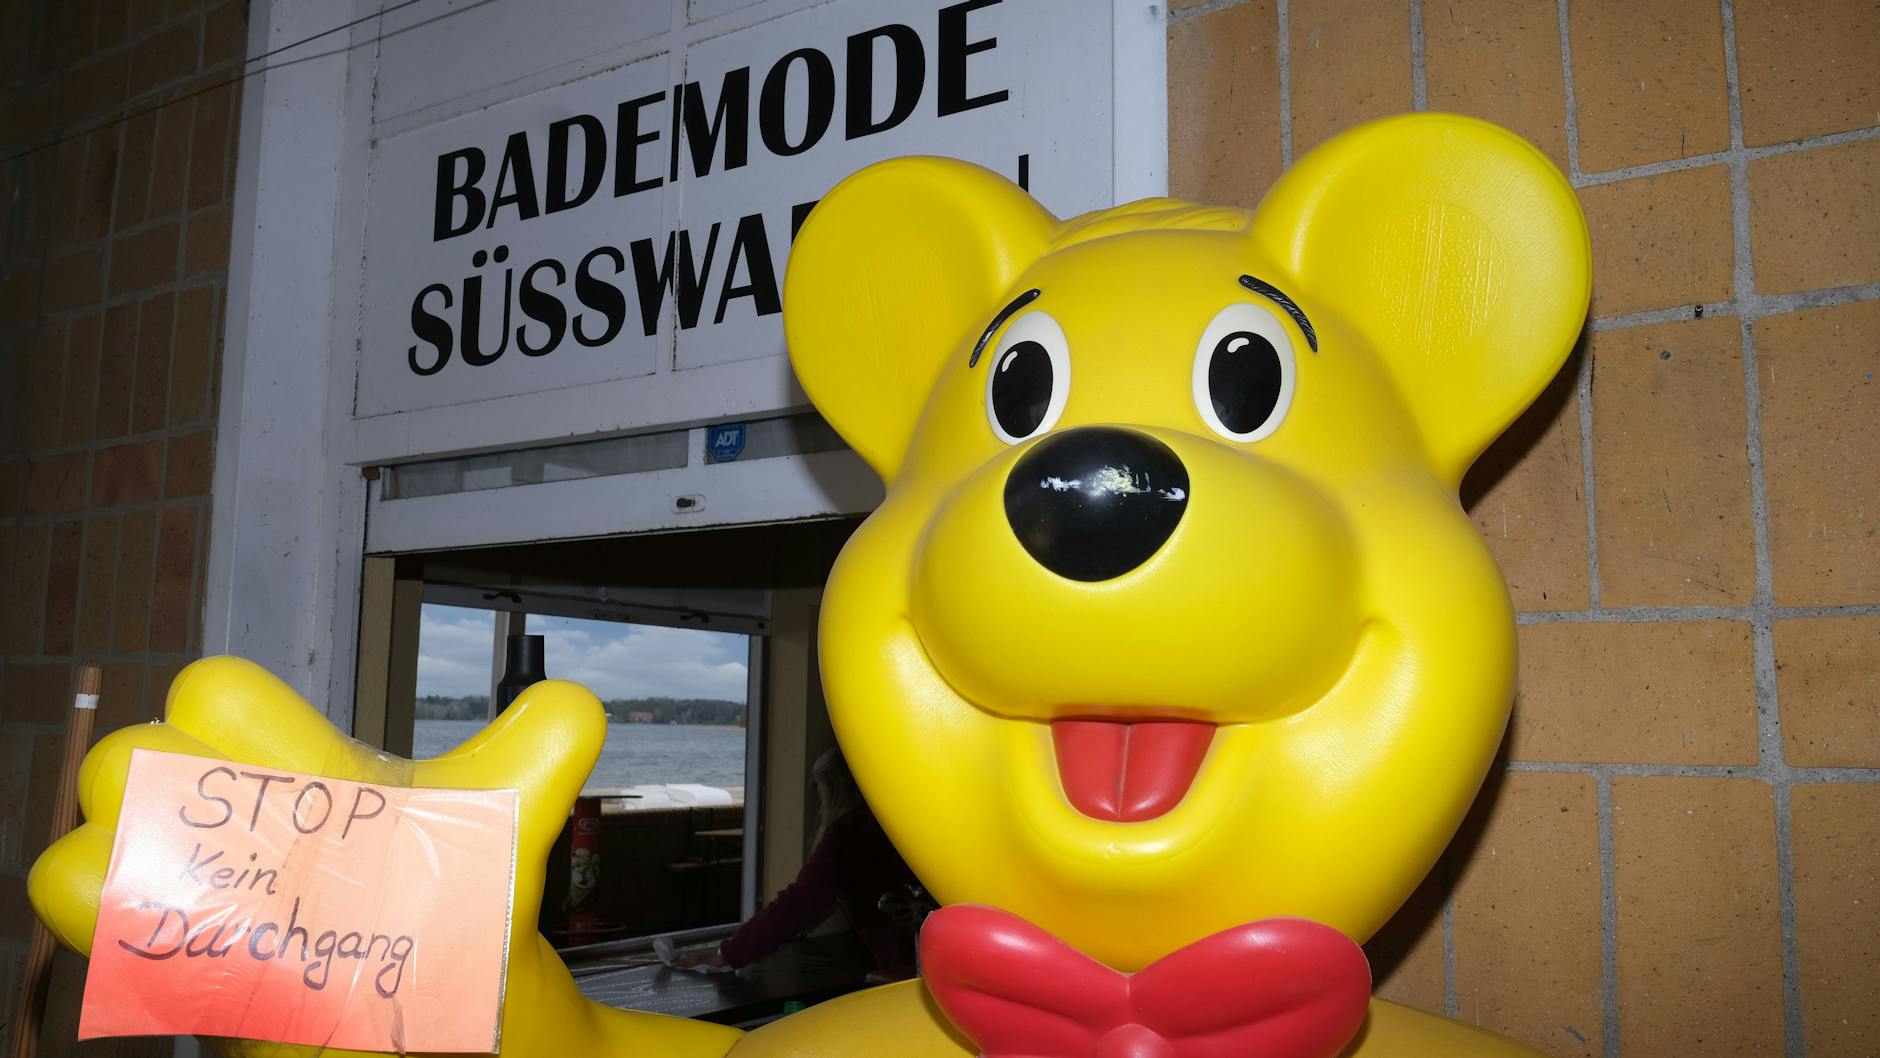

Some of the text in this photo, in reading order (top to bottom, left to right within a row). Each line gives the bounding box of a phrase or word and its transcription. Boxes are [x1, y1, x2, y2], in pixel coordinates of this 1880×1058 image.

[433, 0, 1009, 241] BADEMODE
[715, 430, 739, 447] ADT
[178, 766, 386, 840] STOP
[179, 842, 278, 896] Kein
[118, 896, 414, 999] Durchgang
